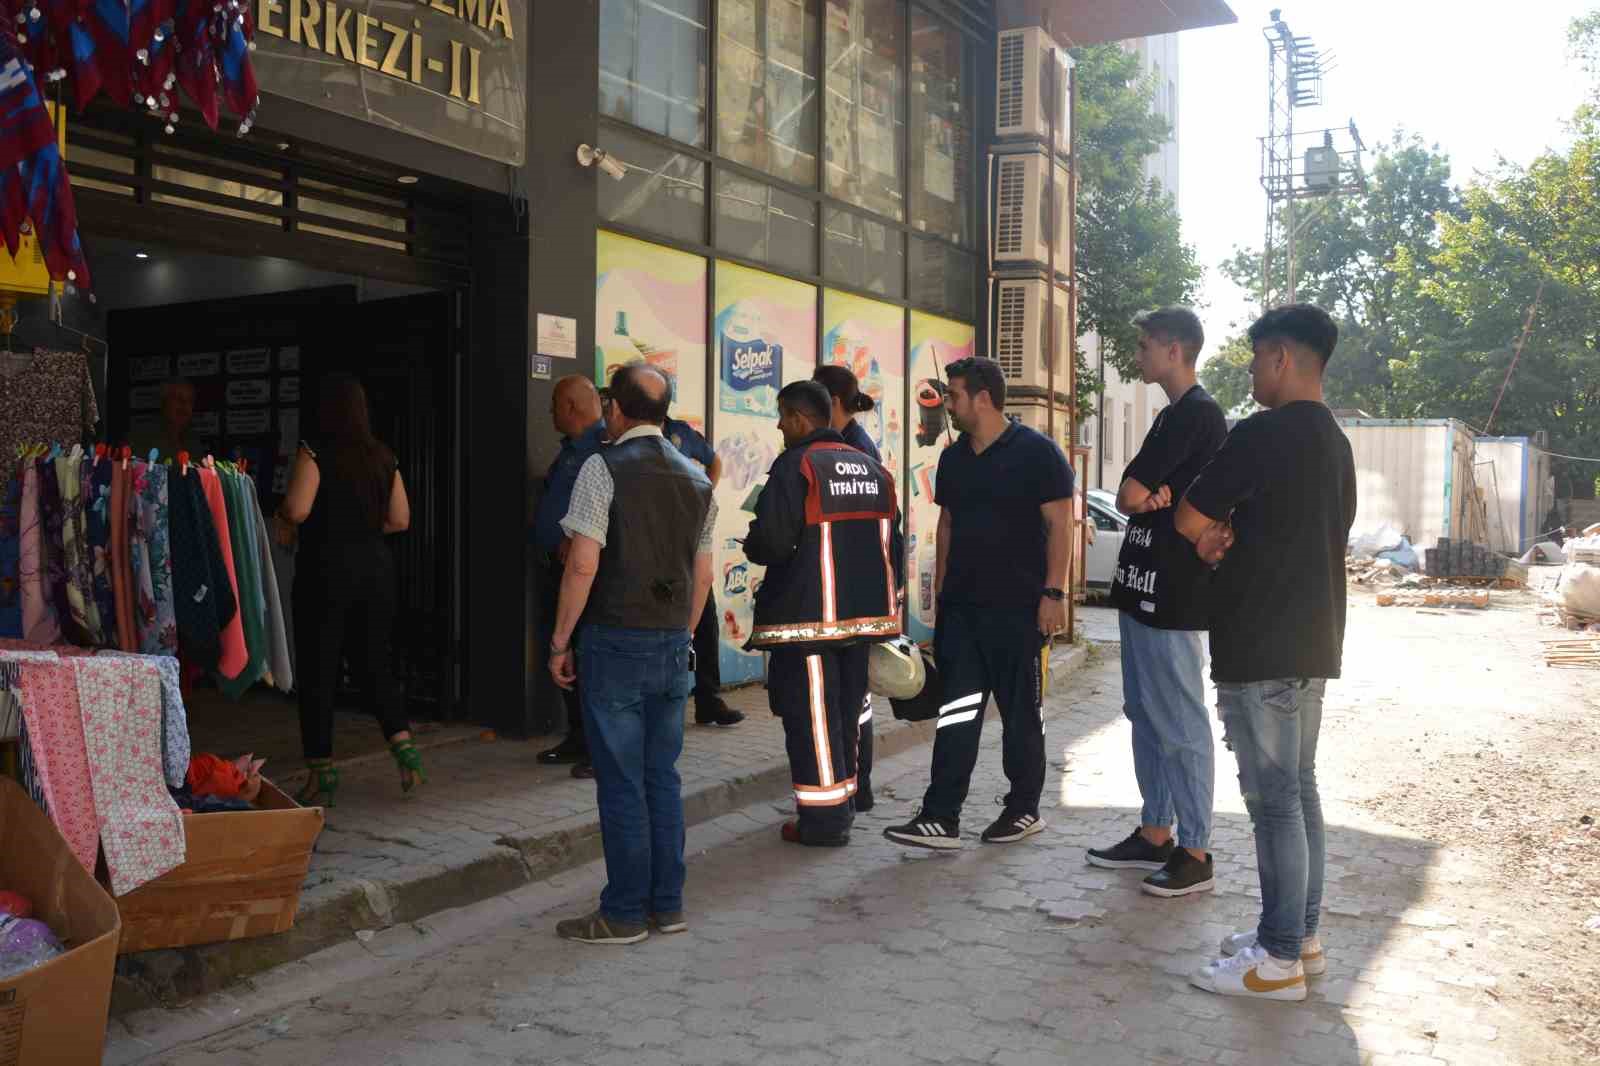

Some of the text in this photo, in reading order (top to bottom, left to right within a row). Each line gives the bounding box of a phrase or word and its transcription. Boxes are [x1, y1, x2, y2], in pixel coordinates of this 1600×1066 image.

[258, 0, 480, 104] ERKEZİ-II
[732, 345, 773, 372] Selpak
[835, 462, 868, 475] ORDU
[829, 479, 879, 495] İTFAİYESİ
[1126, 564, 1156, 594] Hell
